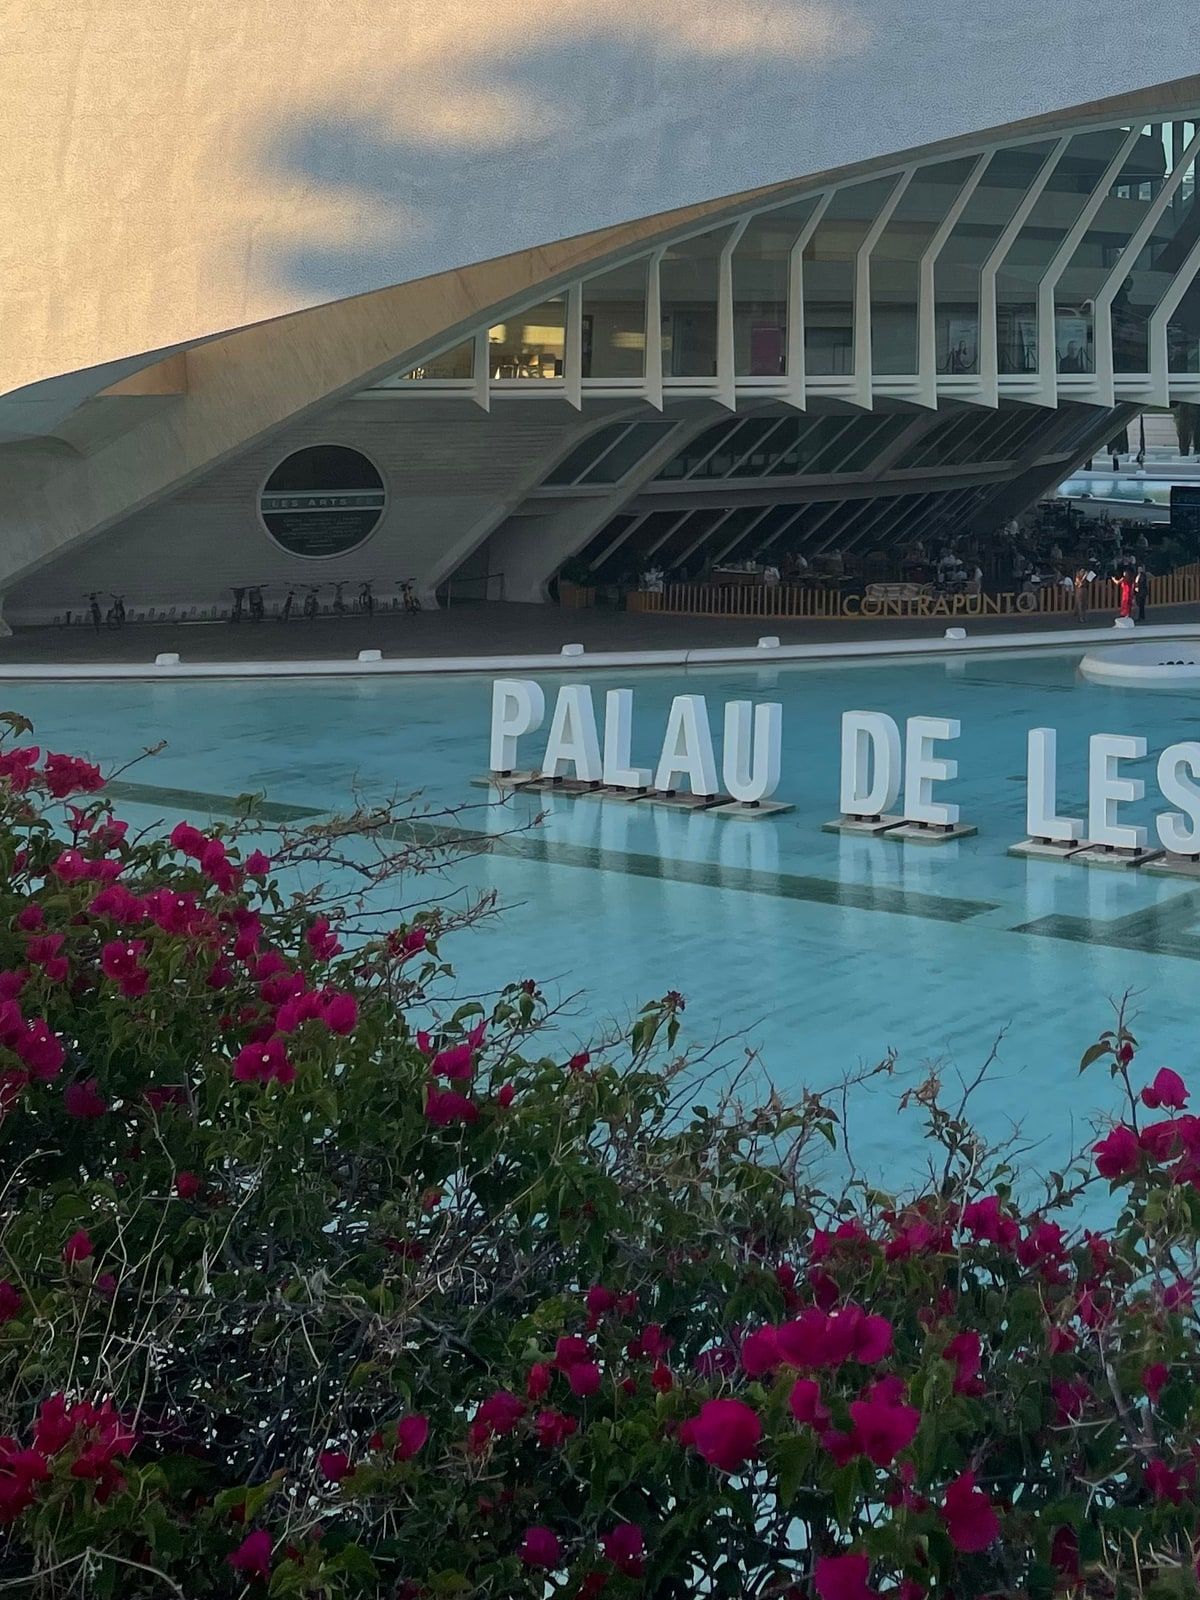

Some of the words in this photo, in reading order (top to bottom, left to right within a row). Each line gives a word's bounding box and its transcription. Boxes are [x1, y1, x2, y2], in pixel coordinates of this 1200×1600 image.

[271, 499, 298, 508] LES
[308, 498, 348, 507] ARTS
[842, 591, 1038, 616] CONTRAPUNTO
[490, 678, 782, 802] PALAU
[840, 710, 961, 825] DE
